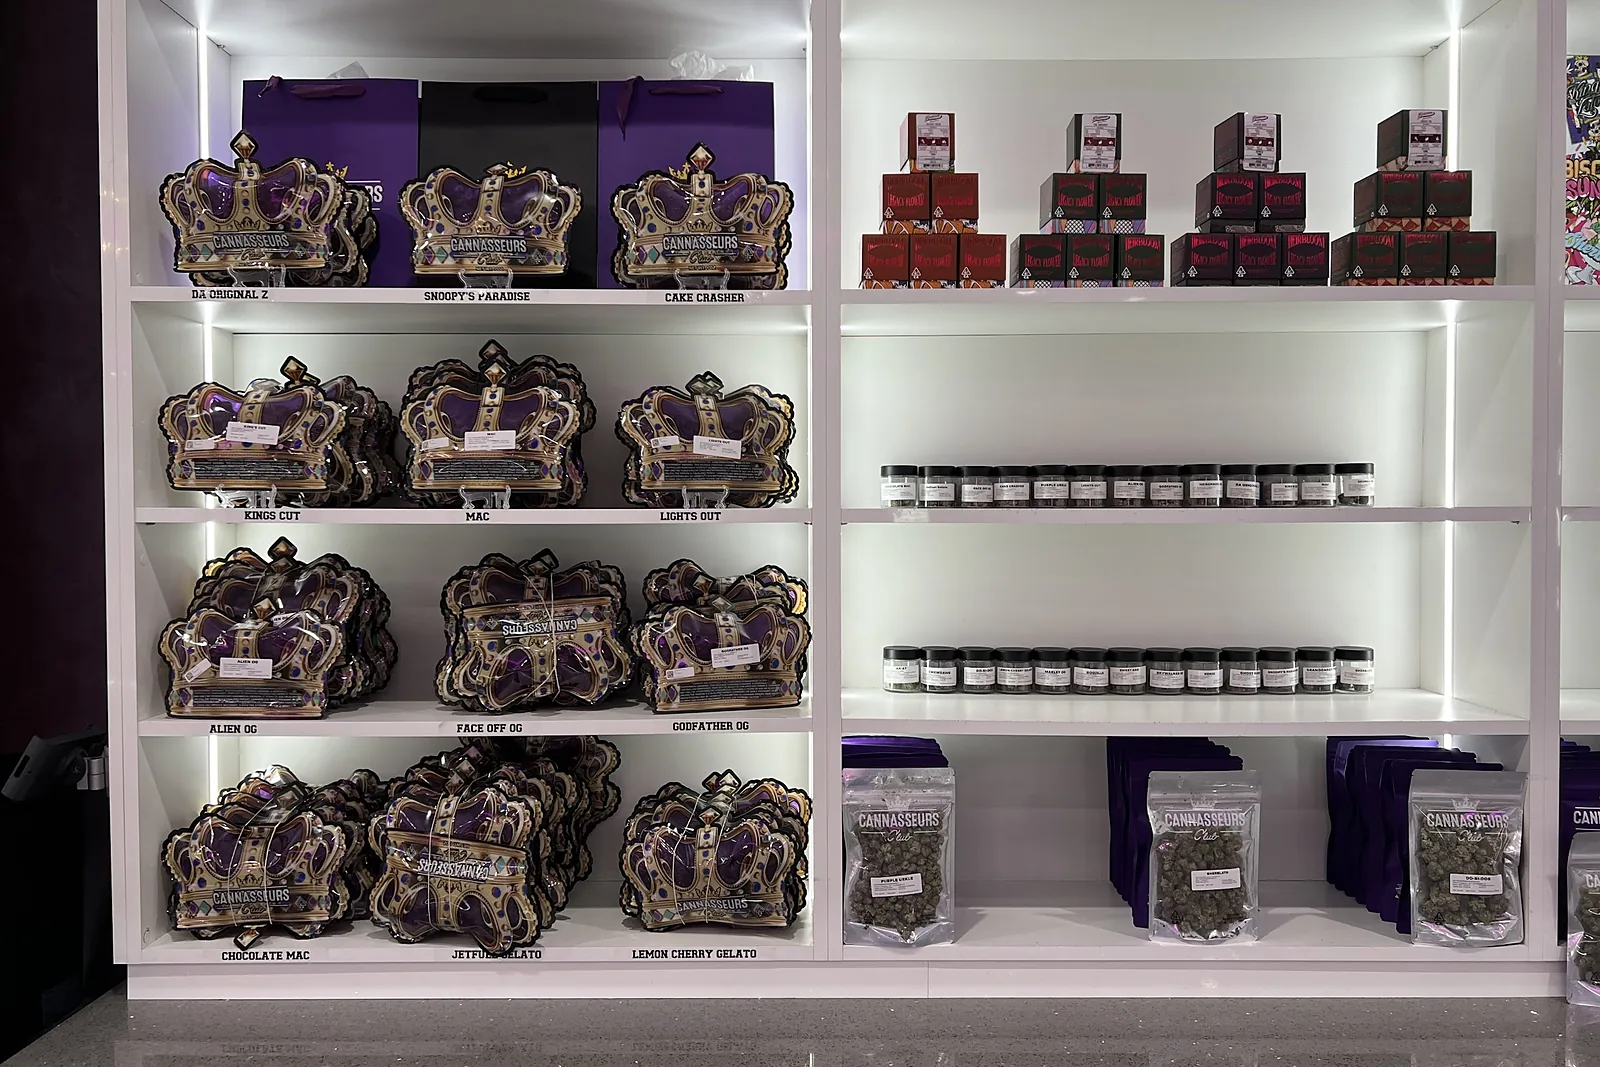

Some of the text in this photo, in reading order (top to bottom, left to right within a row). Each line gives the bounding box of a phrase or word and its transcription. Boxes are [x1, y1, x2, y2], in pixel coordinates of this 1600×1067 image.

[213, 233, 290, 250] CANNASSEURS
[450, 237, 527, 253] CANNASSEURS
[662, 235, 738, 250] CANNASSEURS
[192, 289, 269, 299] DA ORIGINAL Z
[424, 291, 530, 301] SNOOPY'S PARADISE
[665, 292, 745, 302] CAKE CRASHER
[244, 511, 301, 520] KINGS CUT
[465, 512, 490, 521] MAC
[660, 511, 722, 521] LIGHTS OUT
[209, 724, 257, 734] ALIEN OG
[456, 723, 523, 733] FACE OFF OG
[672, 721, 750, 731] GODFATHER OG
[859, 812, 940, 828] CANNASSEURS
[1164, 812, 1246, 827] CANNASSEURS
[1427, 812, 1509, 829] CANNASSEURS
[1573, 810, 1600, 825] CAN
[887, 830, 912, 842] Club
[1193, 828, 1219, 841] Club
[213, 889, 290, 905] CANNASSEURS
[677, 898, 748, 912] CANNASSEURS
[221, 951, 310, 961] CHOCOLATE MAC
[632, 949, 757, 959] LEMON CHERRY GELATO
